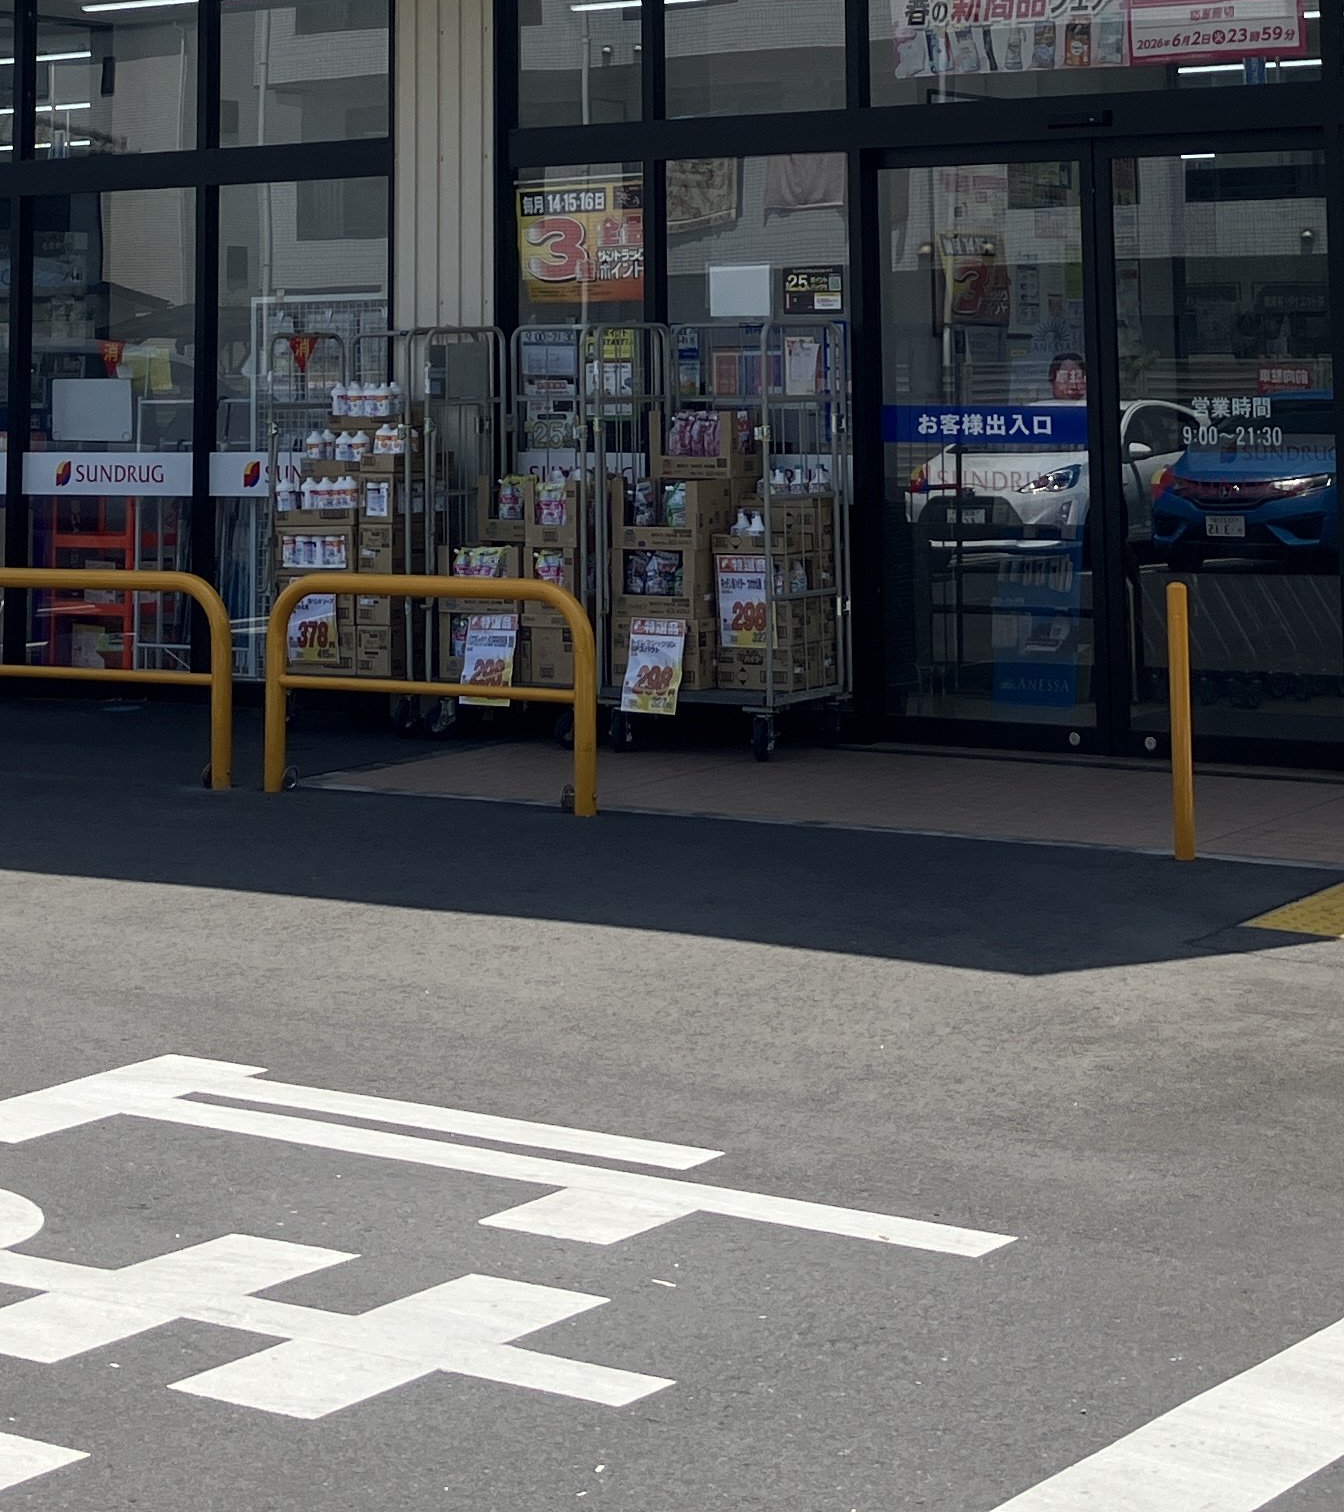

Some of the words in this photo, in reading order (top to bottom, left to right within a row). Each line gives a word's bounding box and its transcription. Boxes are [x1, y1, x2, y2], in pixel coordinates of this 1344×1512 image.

[1191, 396, 1272, 419] 営業時間
[917, 413, 1053, 437] お客様出入口
[75, 464, 165, 484] SUNDRUG
